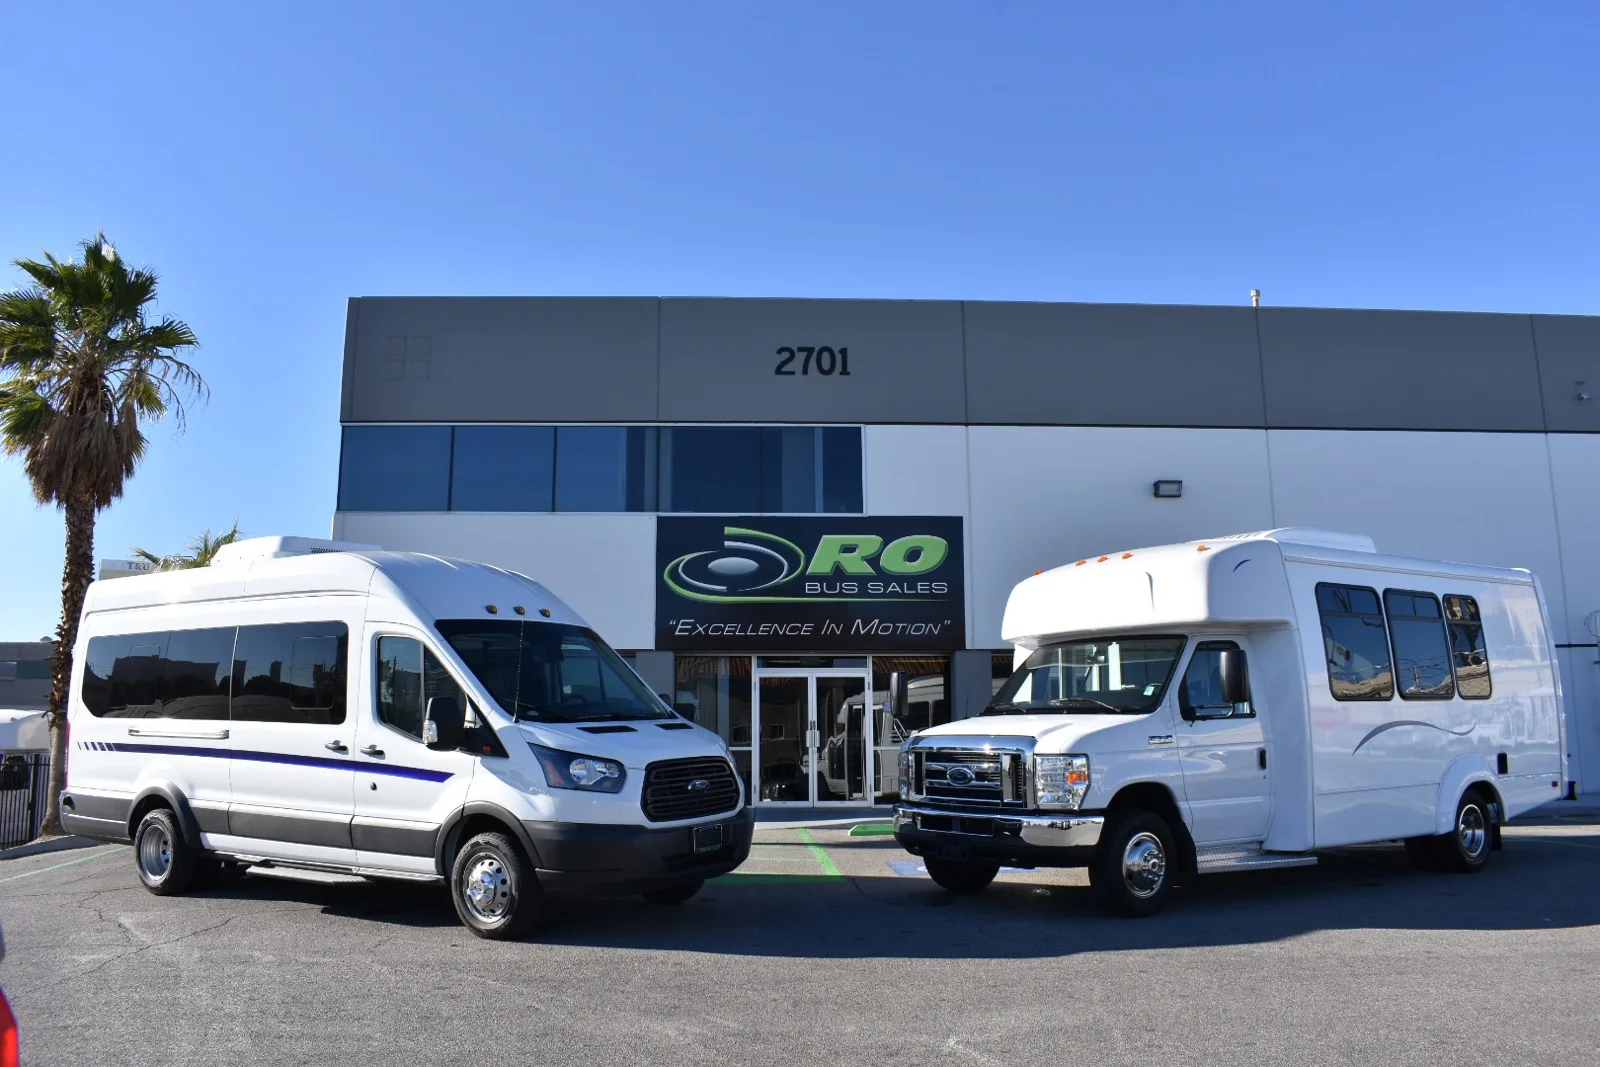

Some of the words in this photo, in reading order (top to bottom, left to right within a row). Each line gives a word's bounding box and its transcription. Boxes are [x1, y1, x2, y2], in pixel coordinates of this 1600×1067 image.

[775, 346, 851, 376] 2701
[805, 534, 949, 576] RO
[805, 582, 858, 594] BUS
[867, 582, 948, 594] SALES
